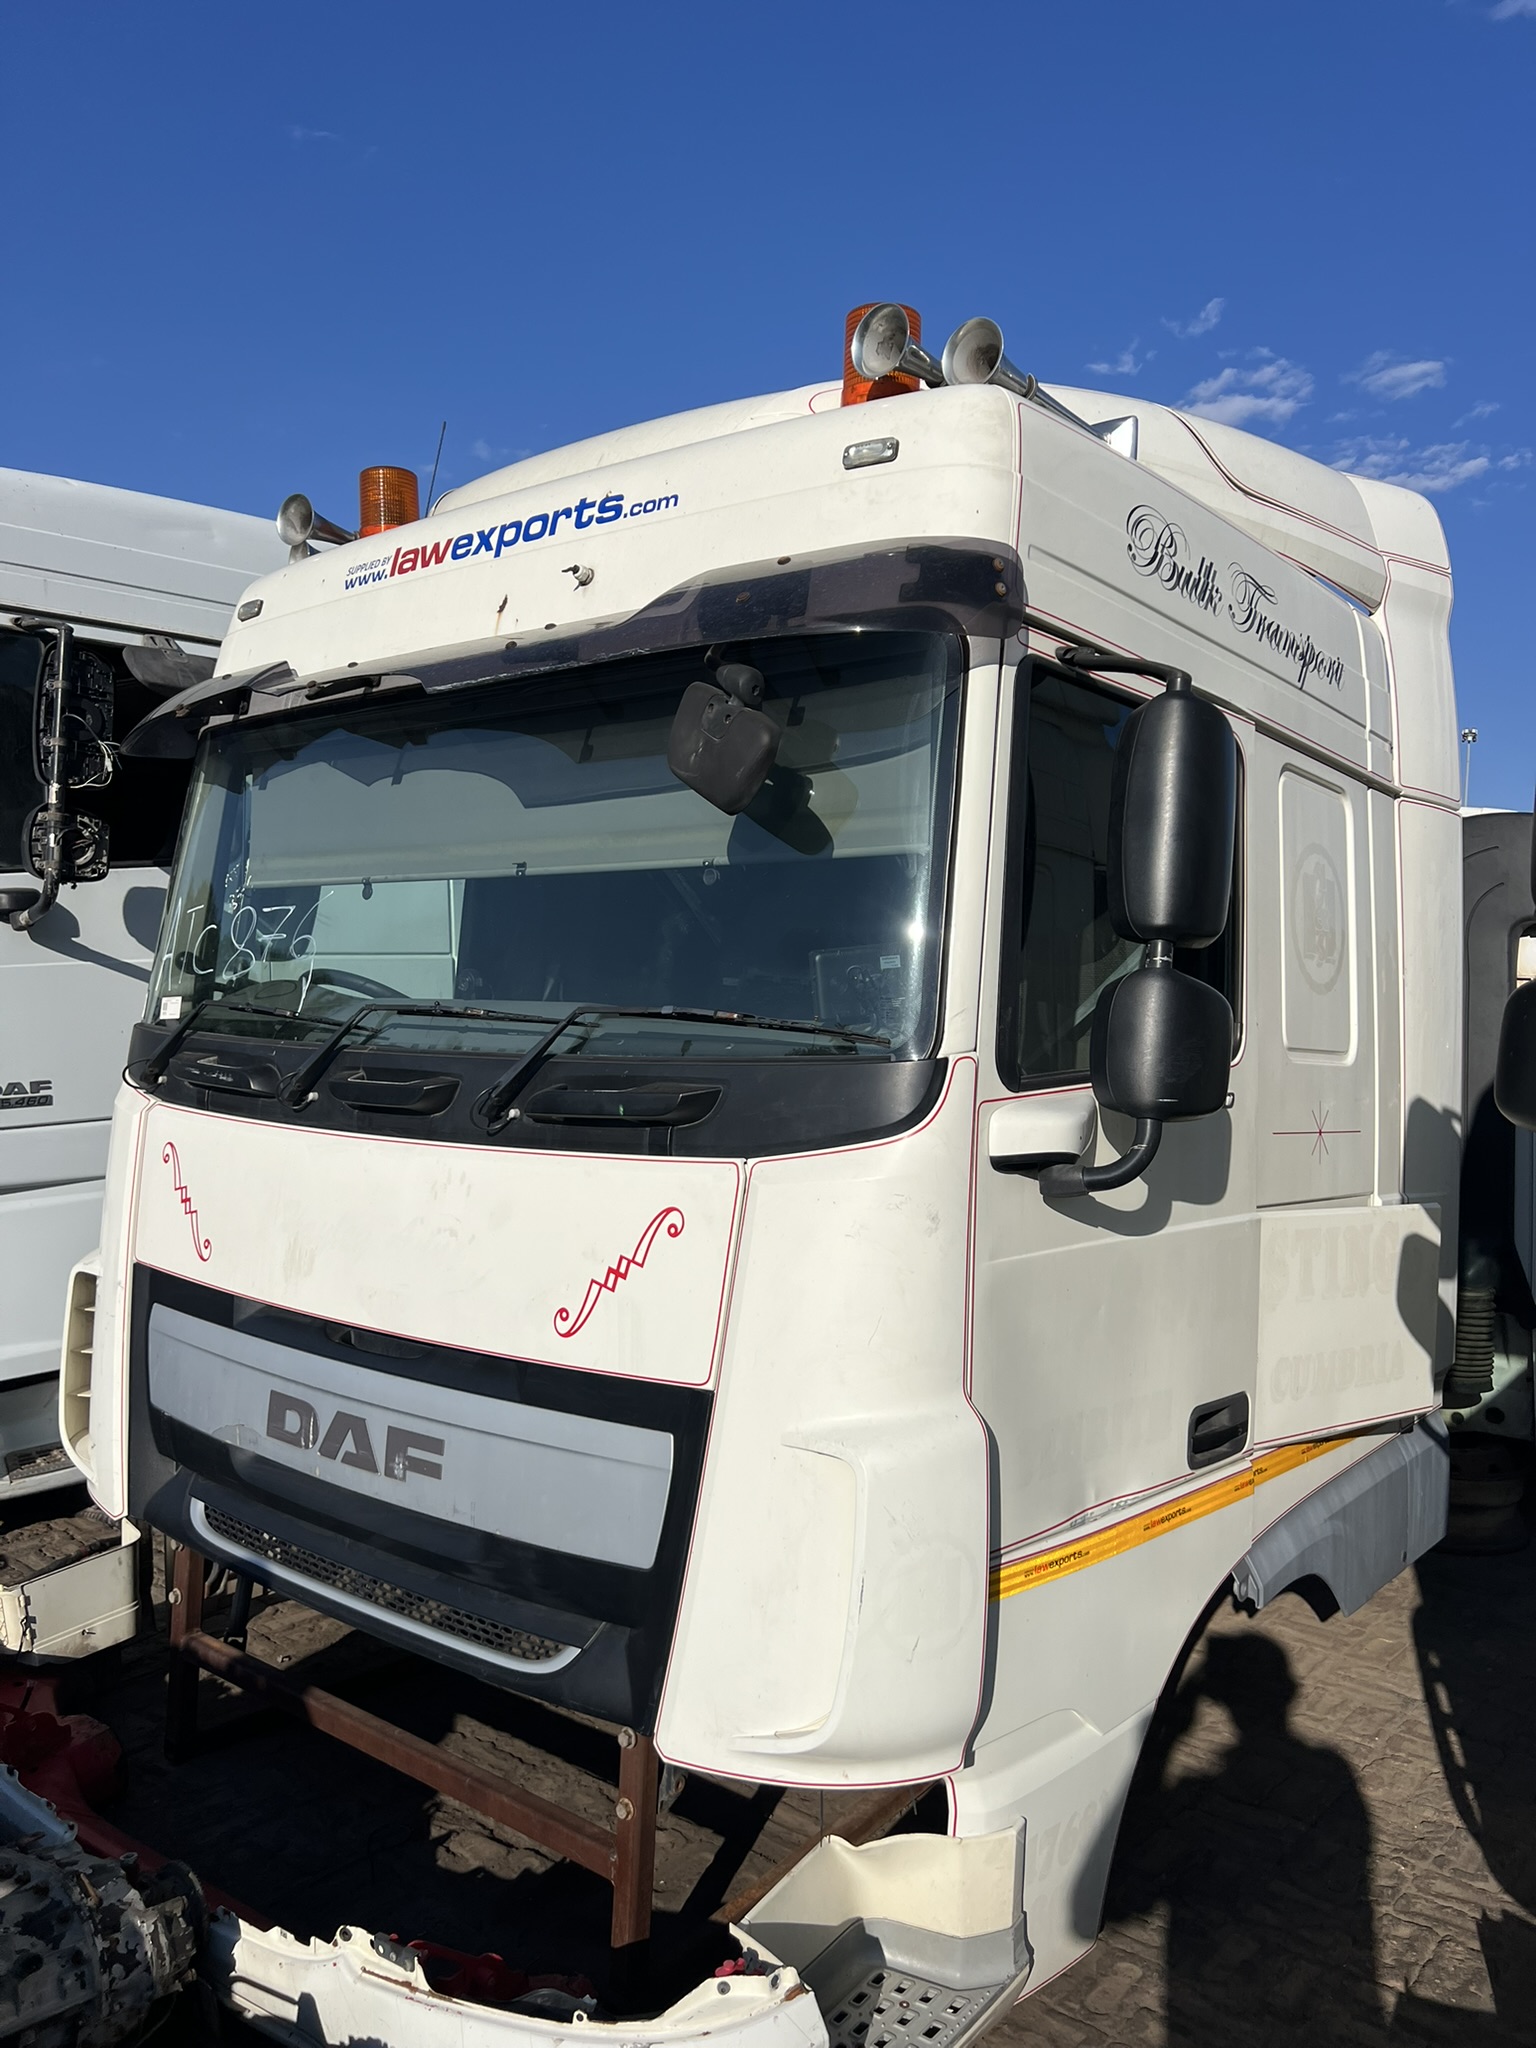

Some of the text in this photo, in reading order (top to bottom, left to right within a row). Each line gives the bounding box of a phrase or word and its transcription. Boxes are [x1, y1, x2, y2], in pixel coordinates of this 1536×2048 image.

[344, 493, 679, 590] www.lawexports.com
[346, 554, 393, 577] SUPPLIED BY
[1126, 504, 1346, 692] Bulk Transport
[0, 1079, 53, 1096] AF
[266, 1389, 446, 1483] DAF
